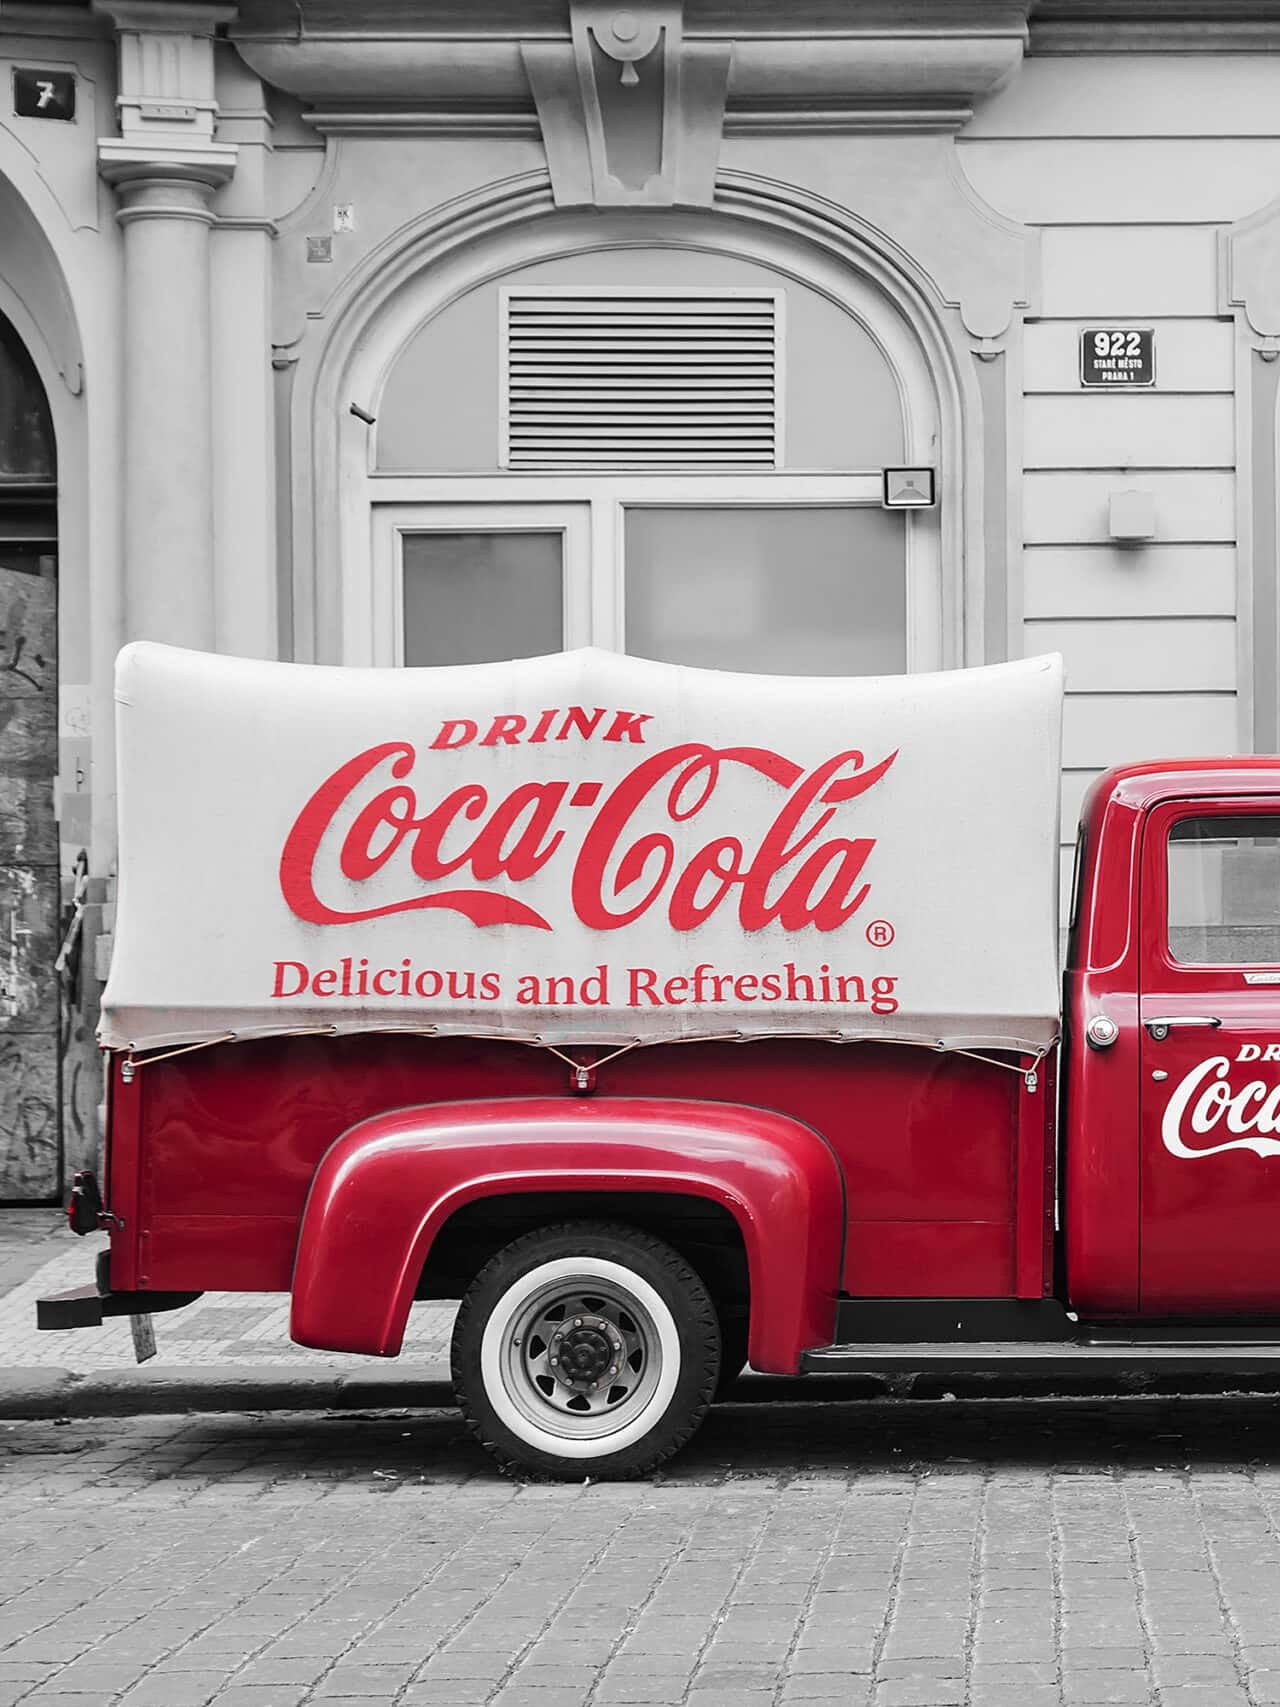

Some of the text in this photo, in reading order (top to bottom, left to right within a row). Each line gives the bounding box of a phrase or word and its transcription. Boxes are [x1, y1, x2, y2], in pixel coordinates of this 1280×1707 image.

[36, 81, 55, 108] 7
[1094, 332, 1141, 357] 922
[1130, 371, 1134, 380] 1
[429, 706, 655, 750] DRINK
[279, 742, 900, 932] Coca-Cola
[271, 957, 900, 1015] Delicious and Refreshing
